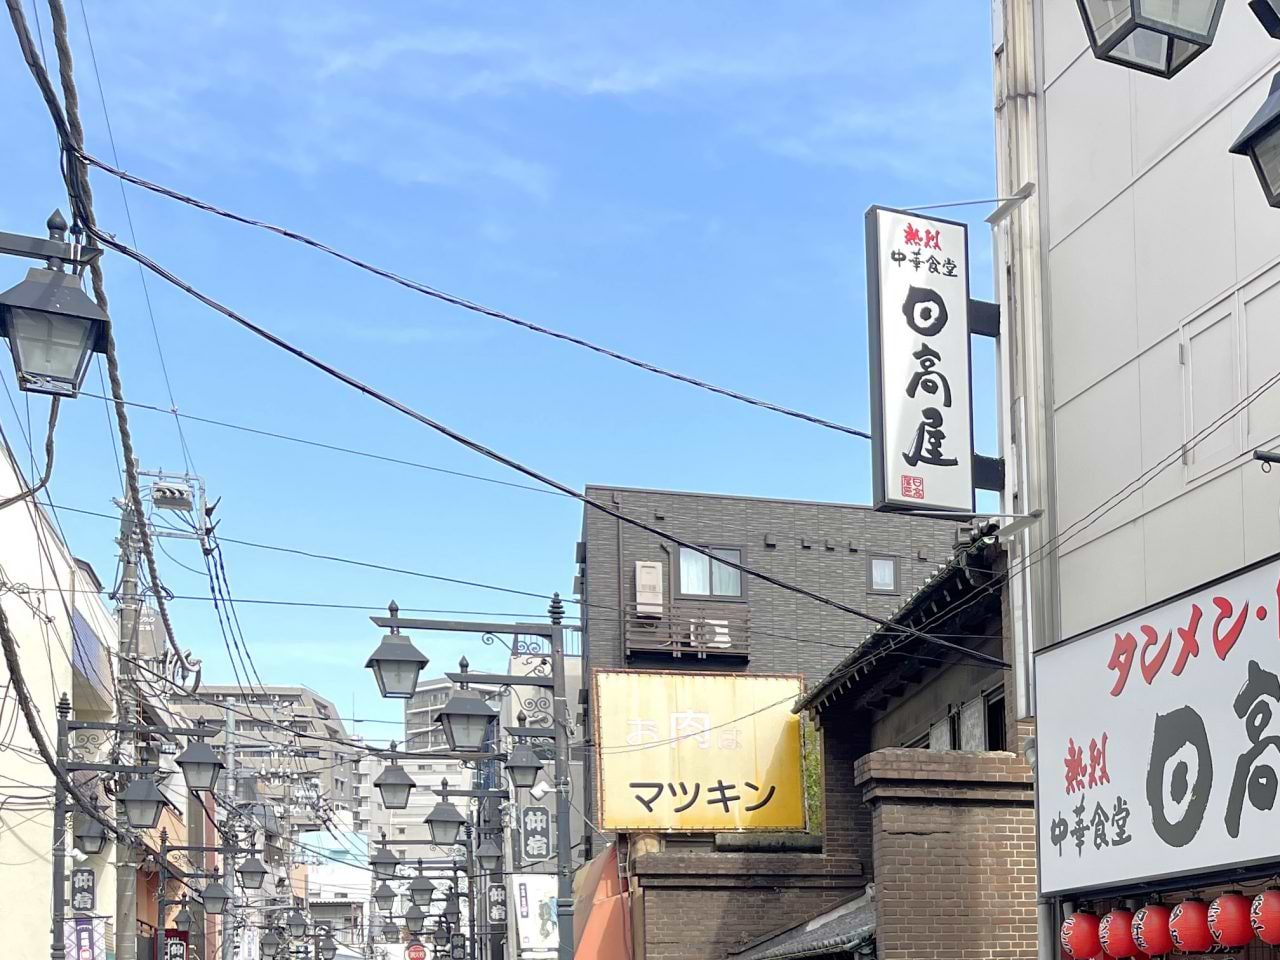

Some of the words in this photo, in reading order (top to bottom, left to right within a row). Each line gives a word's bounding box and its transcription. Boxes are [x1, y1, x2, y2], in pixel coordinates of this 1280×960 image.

[890, 249, 959, 278] 中華食堂
[902, 284, 959, 468] 日高屋
[625, 708, 743, 751] お肉は
[628, 778, 776, 813] マツキン
[525, 810, 548, 857] 仲宿
[1050, 794, 1132, 858] 中華食堂
[73, 871, 93, 909] 仲宿
[489, 887, 507, 922] 仲宿
